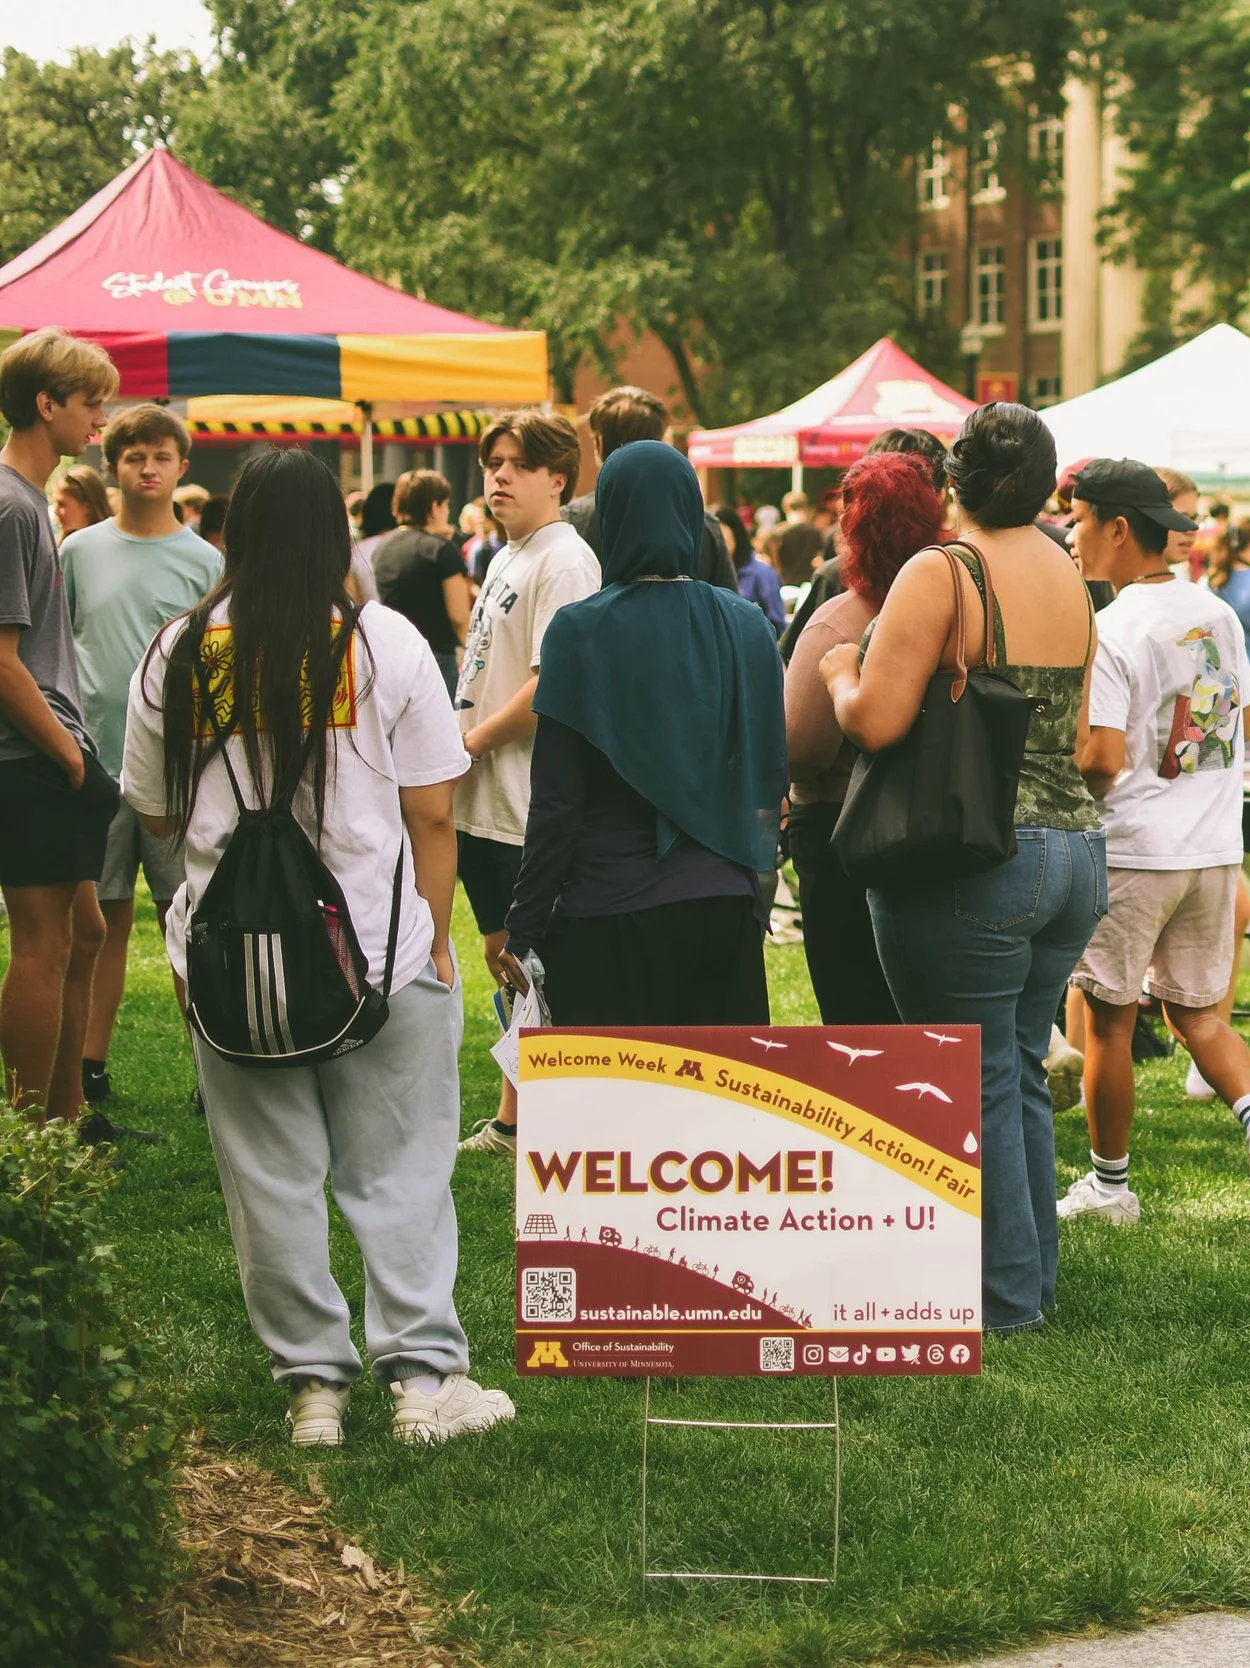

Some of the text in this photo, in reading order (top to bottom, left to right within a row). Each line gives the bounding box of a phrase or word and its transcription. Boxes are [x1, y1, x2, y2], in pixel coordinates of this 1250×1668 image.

[528, 1050, 611, 1069] Welcome
[618, 1051, 668, 1074] Week
[714, 1069, 857, 1140] Sustainability
[858, 1128, 936, 1176] Action!
[934, 1165, 976, 1200] Fair
[525, 1150, 834, 1195] WELCOME!
[656, 1205, 935, 1232] Climate Action + U!
[579, 1303, 763, 1322] sustainable.umn.edu
[833, 1304, 848, 1321] it
[854, 1302, 876, 1321] all
[893, 1301, 943, 1321] adds
[949, 1307, 975, 1325] up
[572, 1341, 675, 1353] Office of Sustainability
[573, 1359, 618, 1368] UNIVERSITY
[630, 1359, 673, 1368] MINNESOTA
